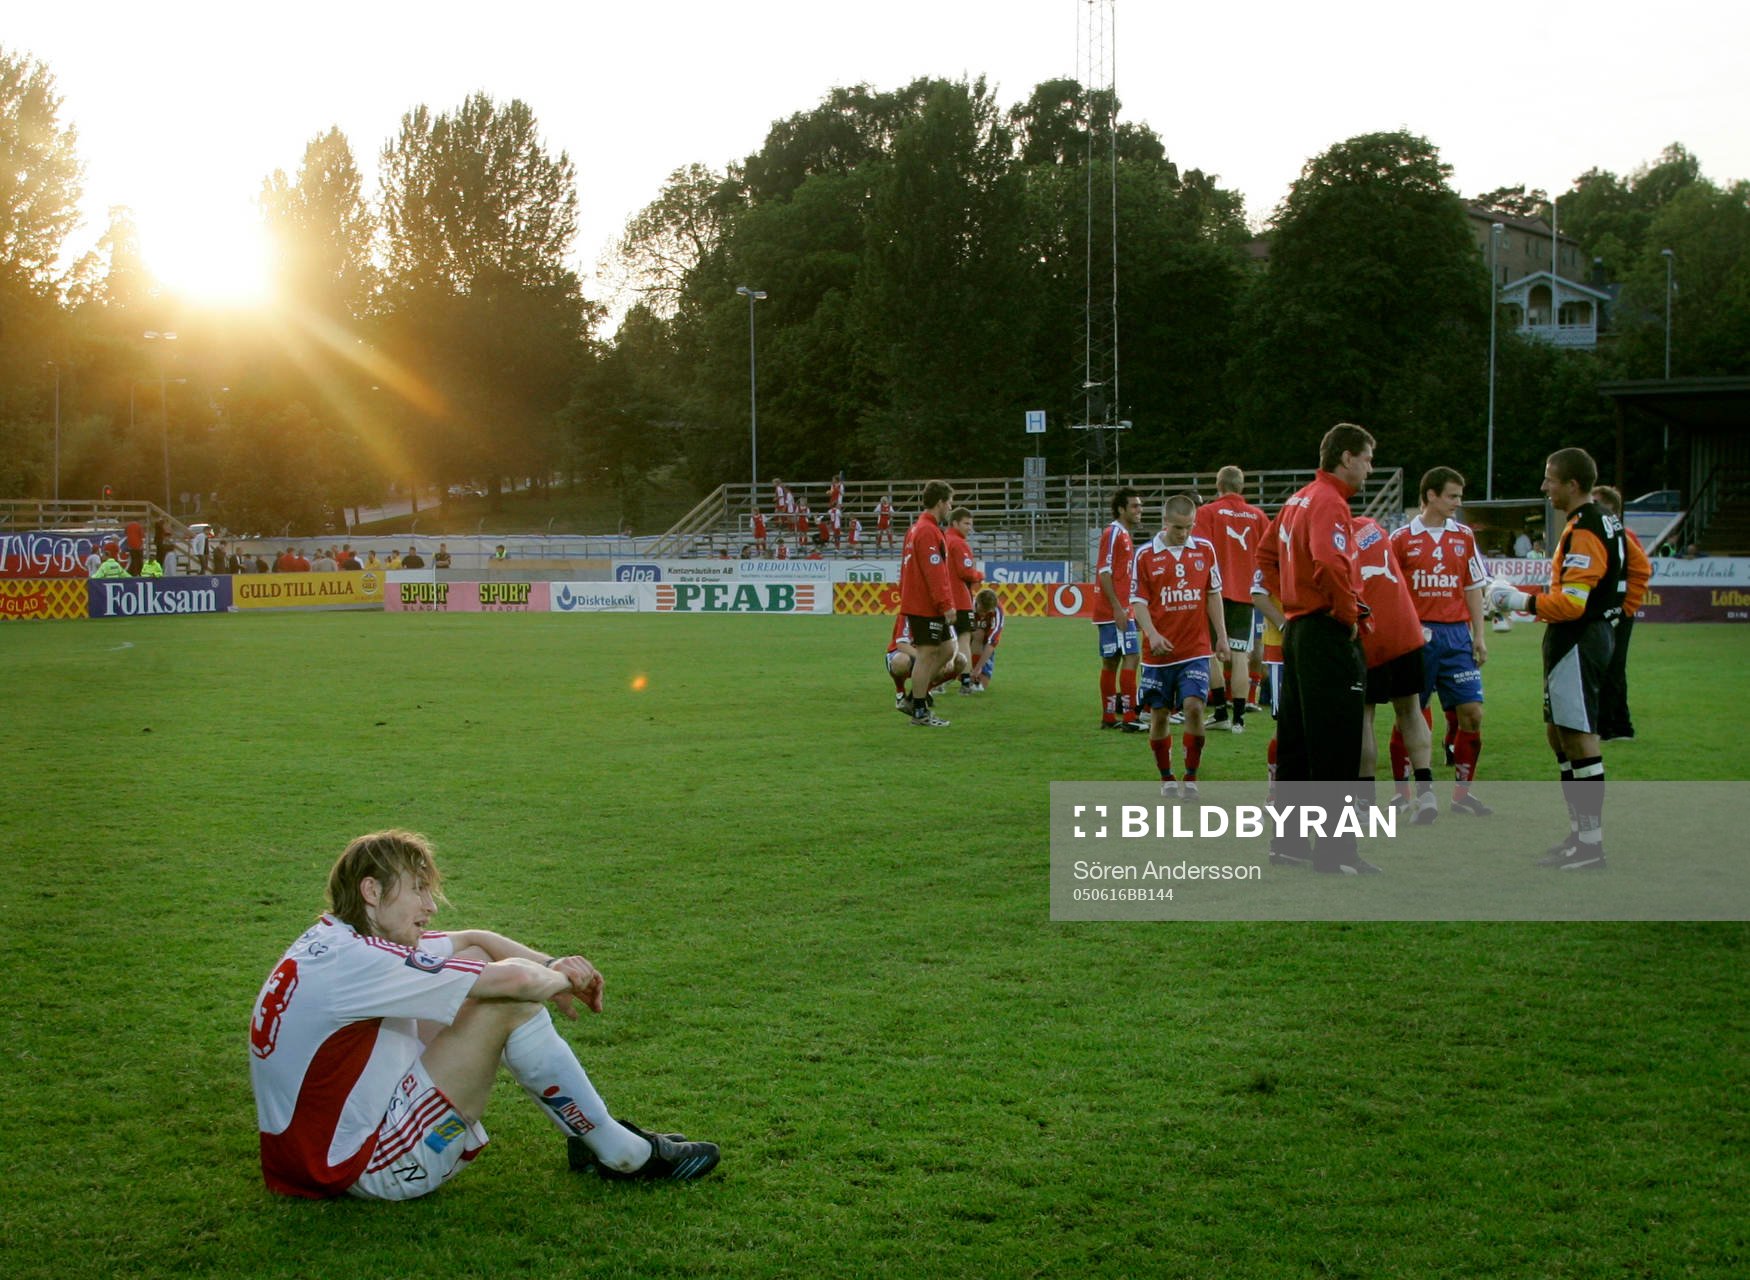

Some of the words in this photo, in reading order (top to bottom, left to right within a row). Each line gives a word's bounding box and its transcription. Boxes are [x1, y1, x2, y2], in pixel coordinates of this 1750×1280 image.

[1432, 546, 1443, 561] 4
[621, 566, 655, 582] elpa
[741, 562, 755, 571] CD
[1175, 563, 1185, 578] 8
[1412, 569, 1459, 590] finax
[239, 583, 281, 598] GULD
[284, 582, 315, 597] TILL
[319, 581, 354, 595] ALLA
[401, 583, 449, 604] SPORT
[479, 583, 531, 604] SPORT
[1160, 586, 1201, 606] finax
[6, 598, 38, 612] GLAD
[577, 595, 636, 606] Diskteknik
[673, 584, 796, 612] PEAB
